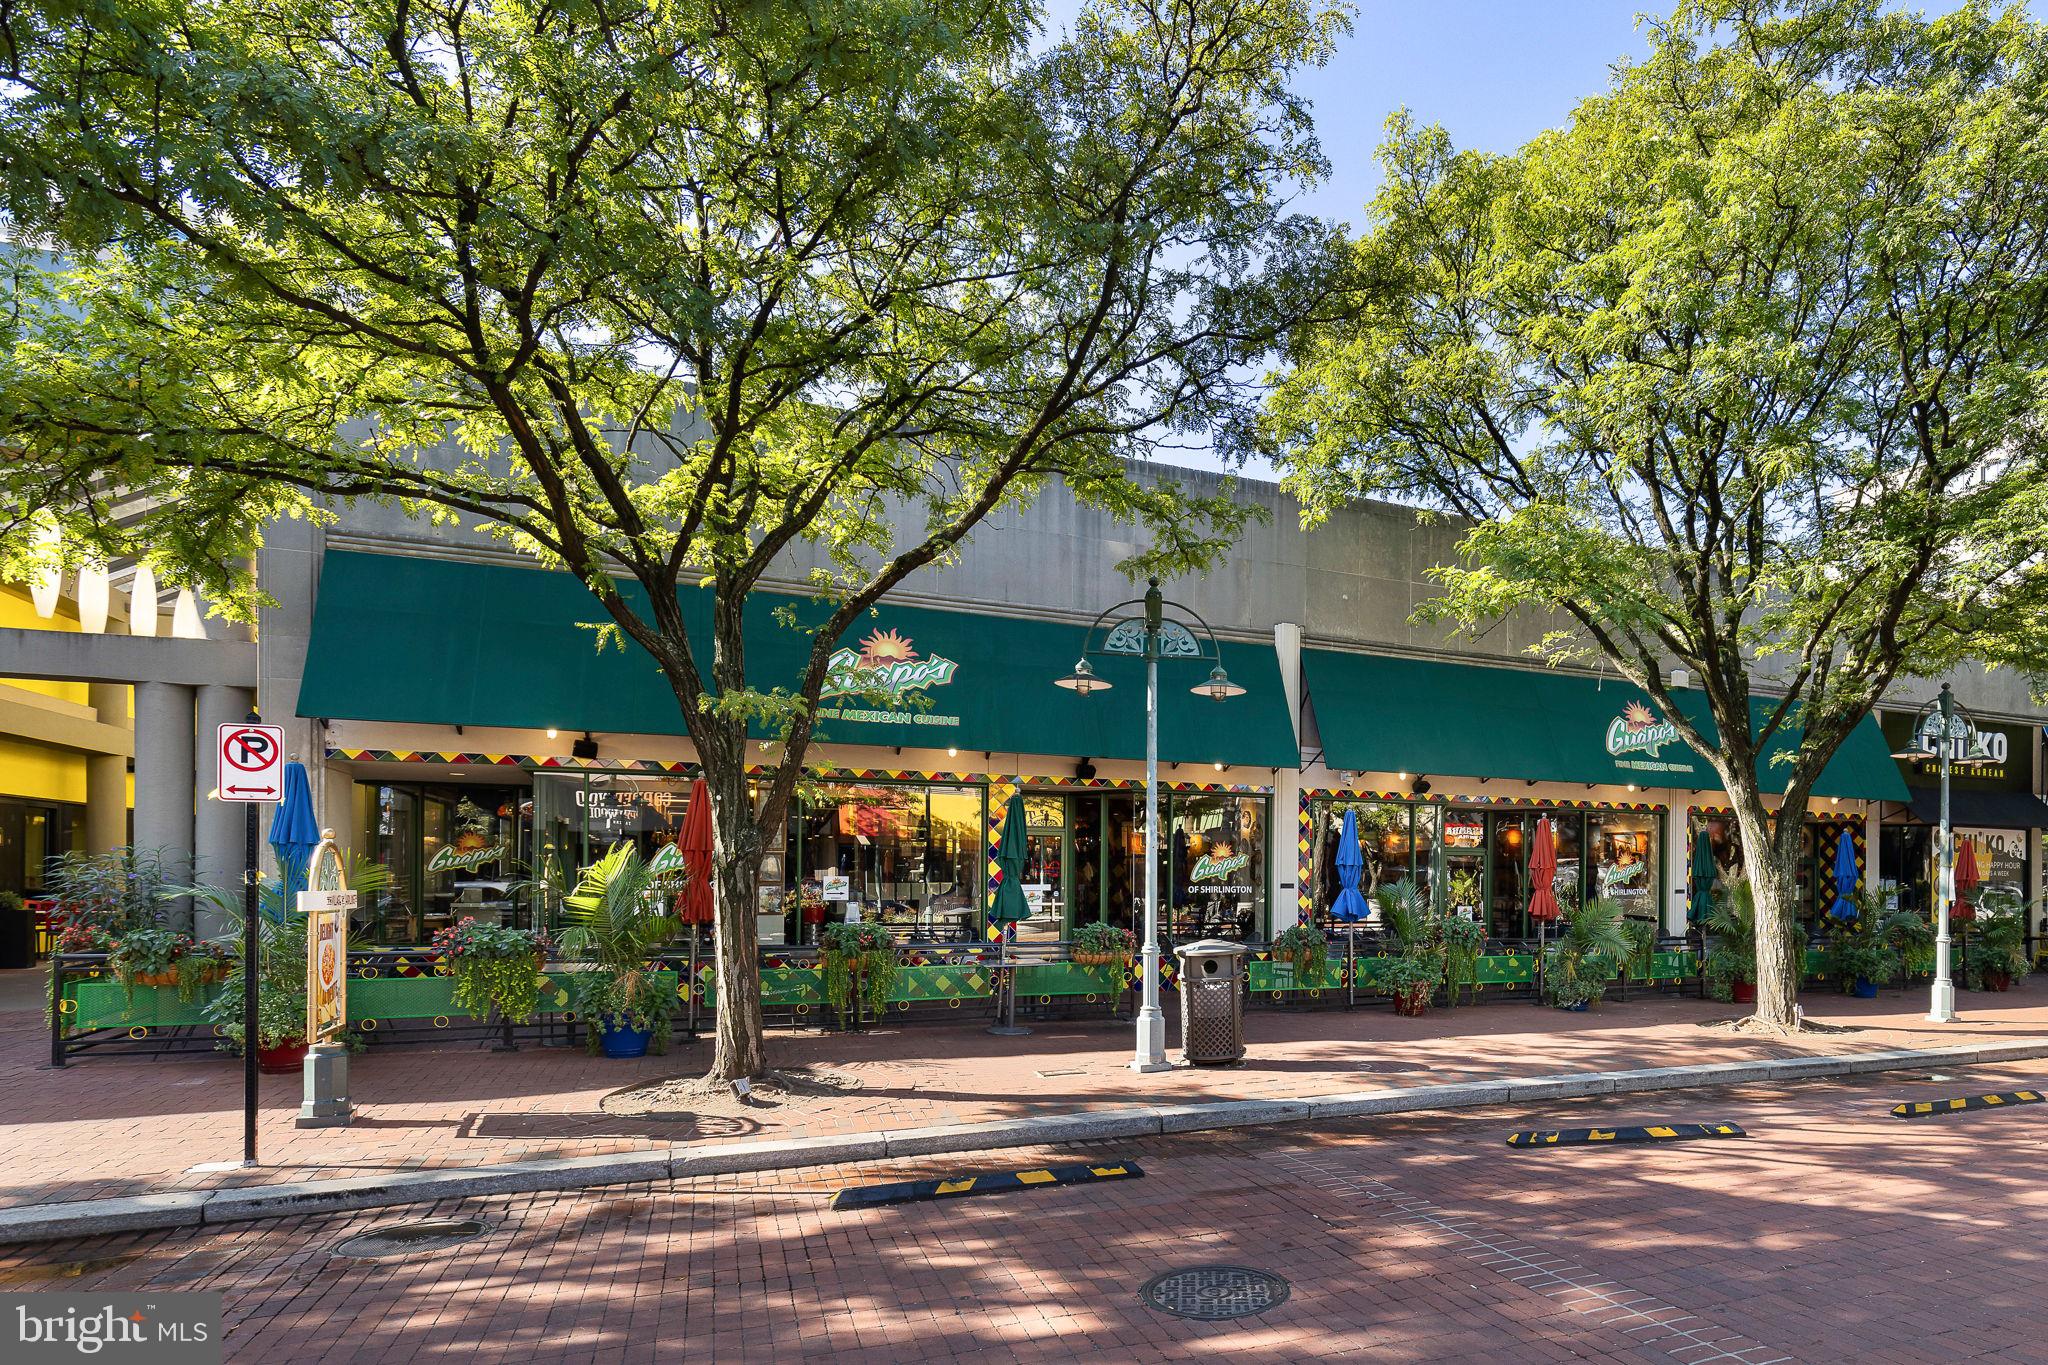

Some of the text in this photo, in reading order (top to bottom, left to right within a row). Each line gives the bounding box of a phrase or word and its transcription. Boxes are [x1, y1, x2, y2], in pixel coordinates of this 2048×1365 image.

[841, 709, 911, 724] MEXICAN
[913, 714, 960, 726] CUISINE
[1608, 718, 1675, 753] Guapo's
[1631, 761, 1668, 771] MEXICAN
[1925, 763, 2004, 778] CHIESE KOREAN
[427, 845, 506, 872] Guapo's
[2004, 861, 2021, 869] HOUR
[1191, 855, 1246, 881] Guapo's
[1188, 885, 1253, 894] OF SHIRLINGTON
